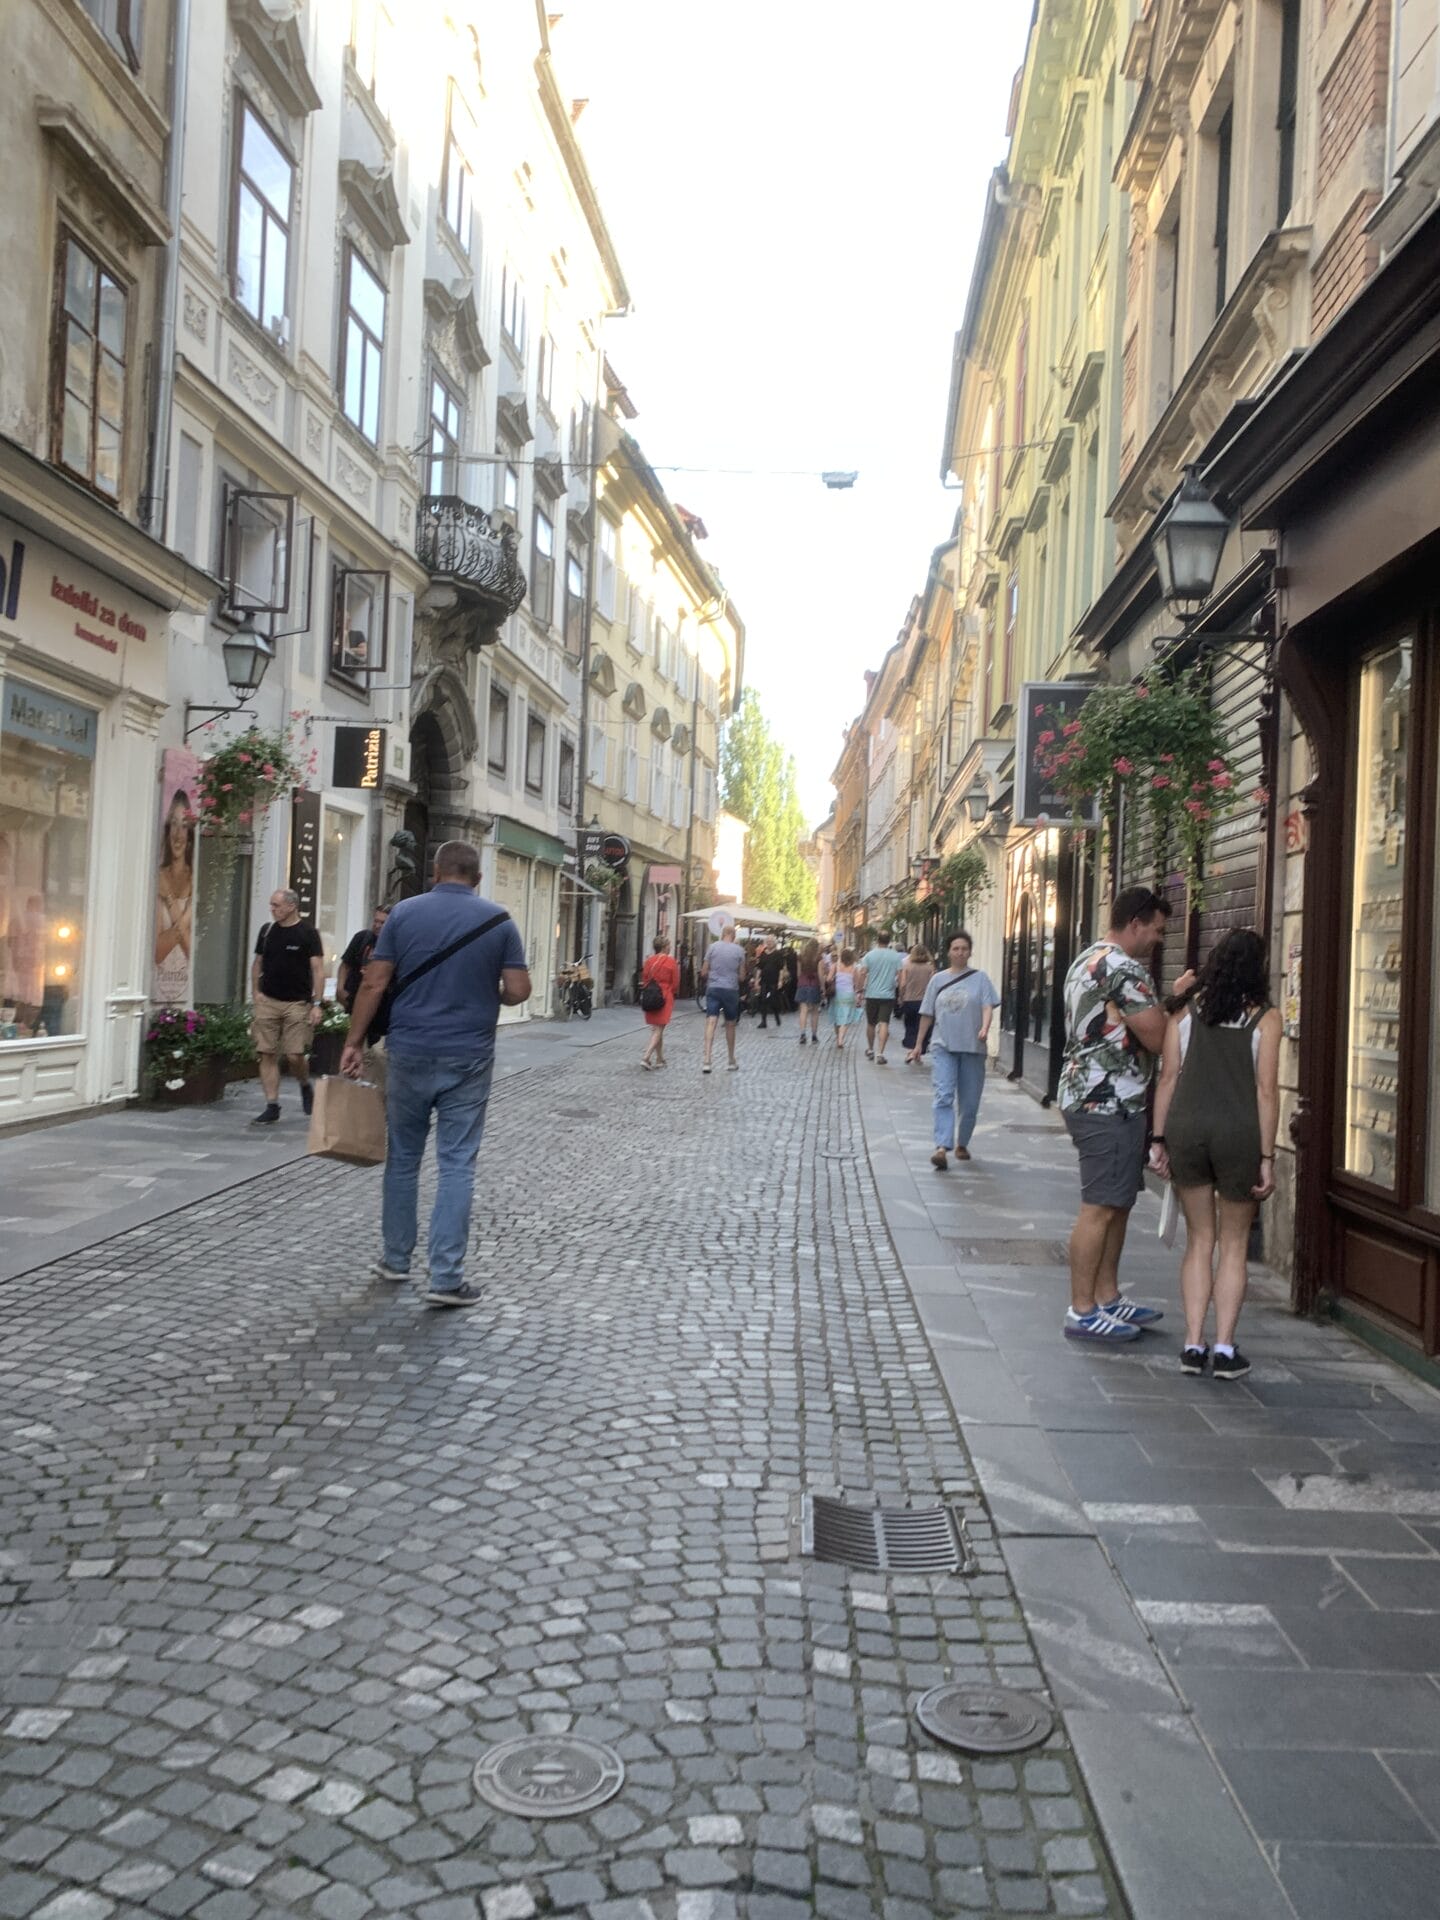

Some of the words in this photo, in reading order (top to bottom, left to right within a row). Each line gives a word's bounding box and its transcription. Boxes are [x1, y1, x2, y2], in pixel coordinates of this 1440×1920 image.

[98, 606, 117, 627] za
[118, 612, 147, 642] dom
[361, 729, 381, 788] Patrizia
